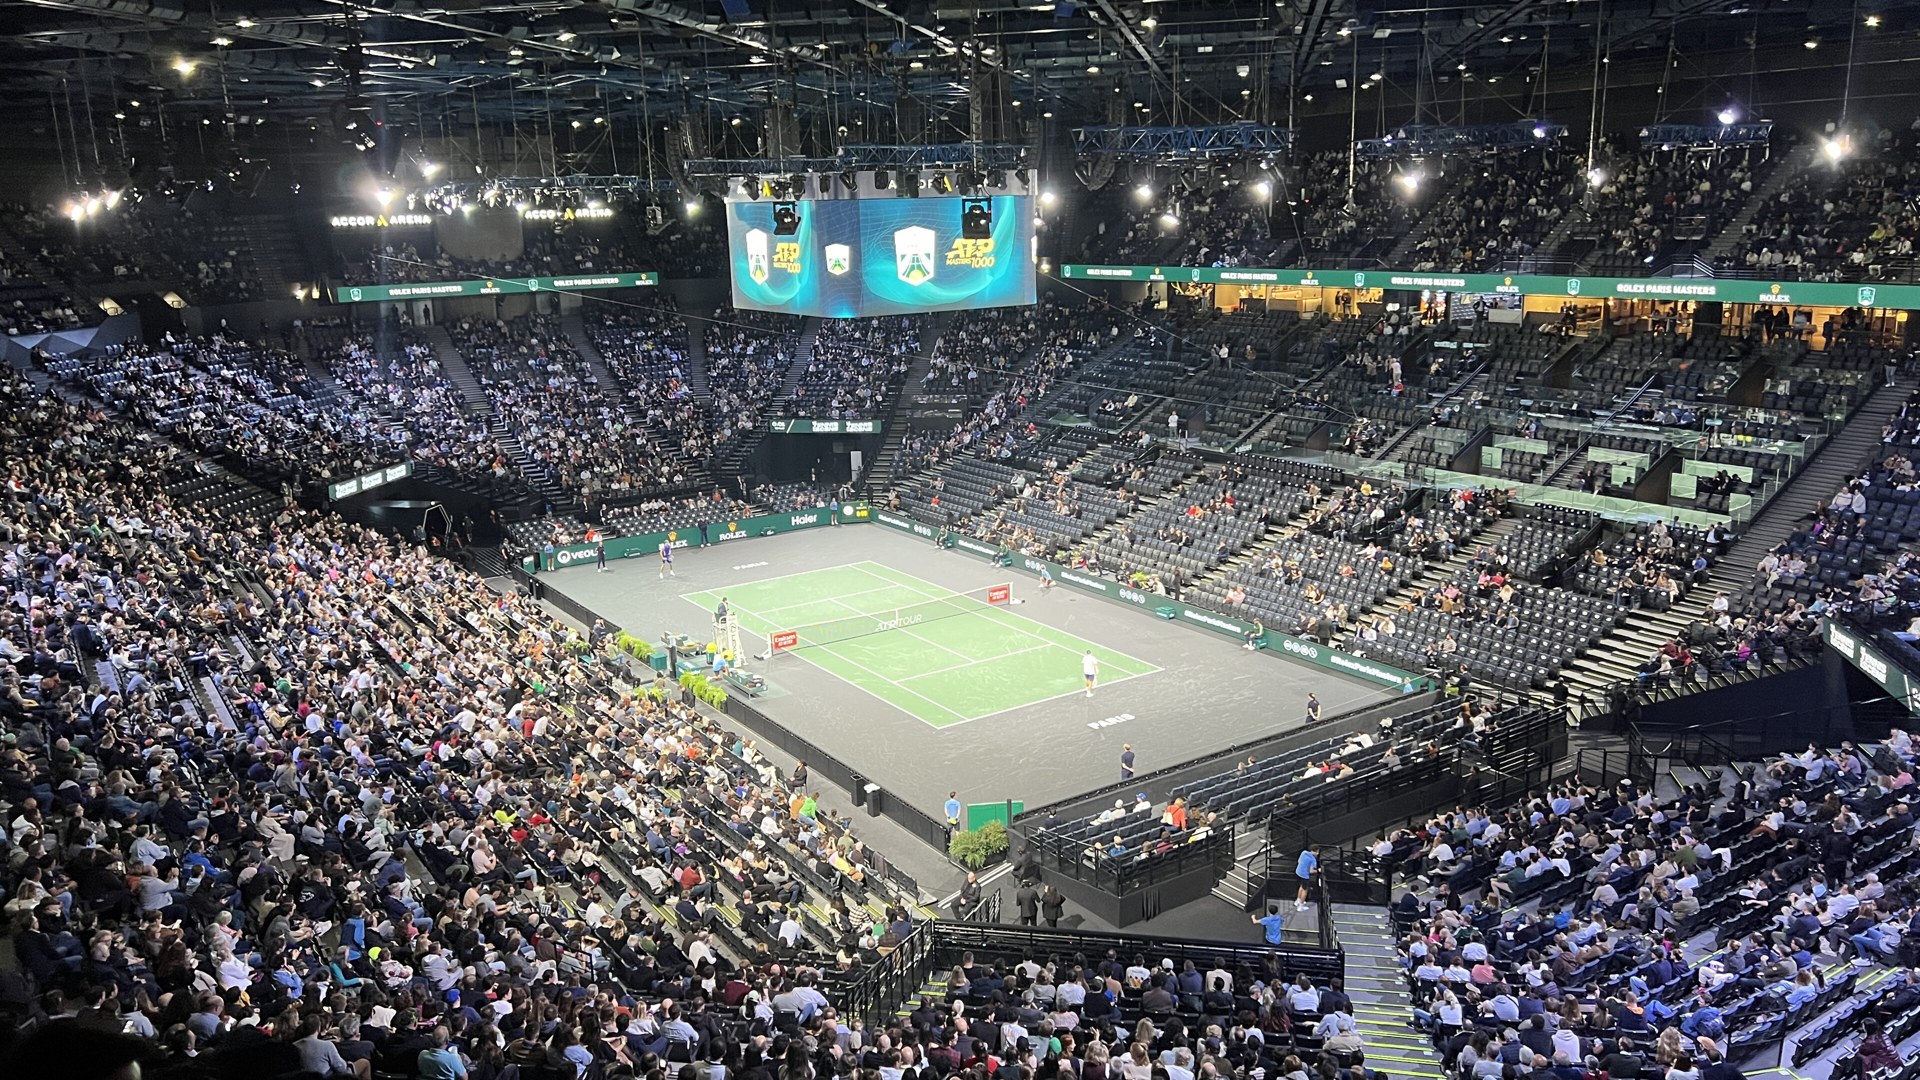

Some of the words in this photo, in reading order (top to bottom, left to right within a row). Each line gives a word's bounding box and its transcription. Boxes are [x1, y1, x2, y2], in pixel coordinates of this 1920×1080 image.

[574, 208, 614, 218] ARENA
[331, 215, 375, 227] ACCOR
[389, 214, 432, 225] ARENA
[772, 242, 800, 263] ATP
[945, 238, 995, 258] ATP
[946, 257, 972, 266] MASTERS
[971, 256, 995, 268] 1000
[592, 277, 619, 285] MASTERS
[1391, 276, 1412, 285] ROLEX
[1413, 277, 1433, 286] PARIS
[1433, 278, 1465, 287] MASTERS
[388, 287, 411, 296] ROLEX
[412, 286, 431, 295] PARIS
[432, 285, 463, 294] MASTERS
[1496, 285, 1519, 293] ROLEX
[1616, 284, 1645, 293] ROLEX
[1645, 285, 1672, 294] PARIS
[1672, 286, 1715, 295] MASTERS
[1759, 294, 1790, 303] ROLEX
[791, 513, 818, 526] Haier
[719, 530, 747, 541] ROLEX
[658, 539, 688, 550] RLEX
[571, 548, 599, 560] VEOL
[898, 614, 923, 627] TOUR
[774, 633, 796, 643] Emirates
[1087, 713, 1136, 730] PARIS
